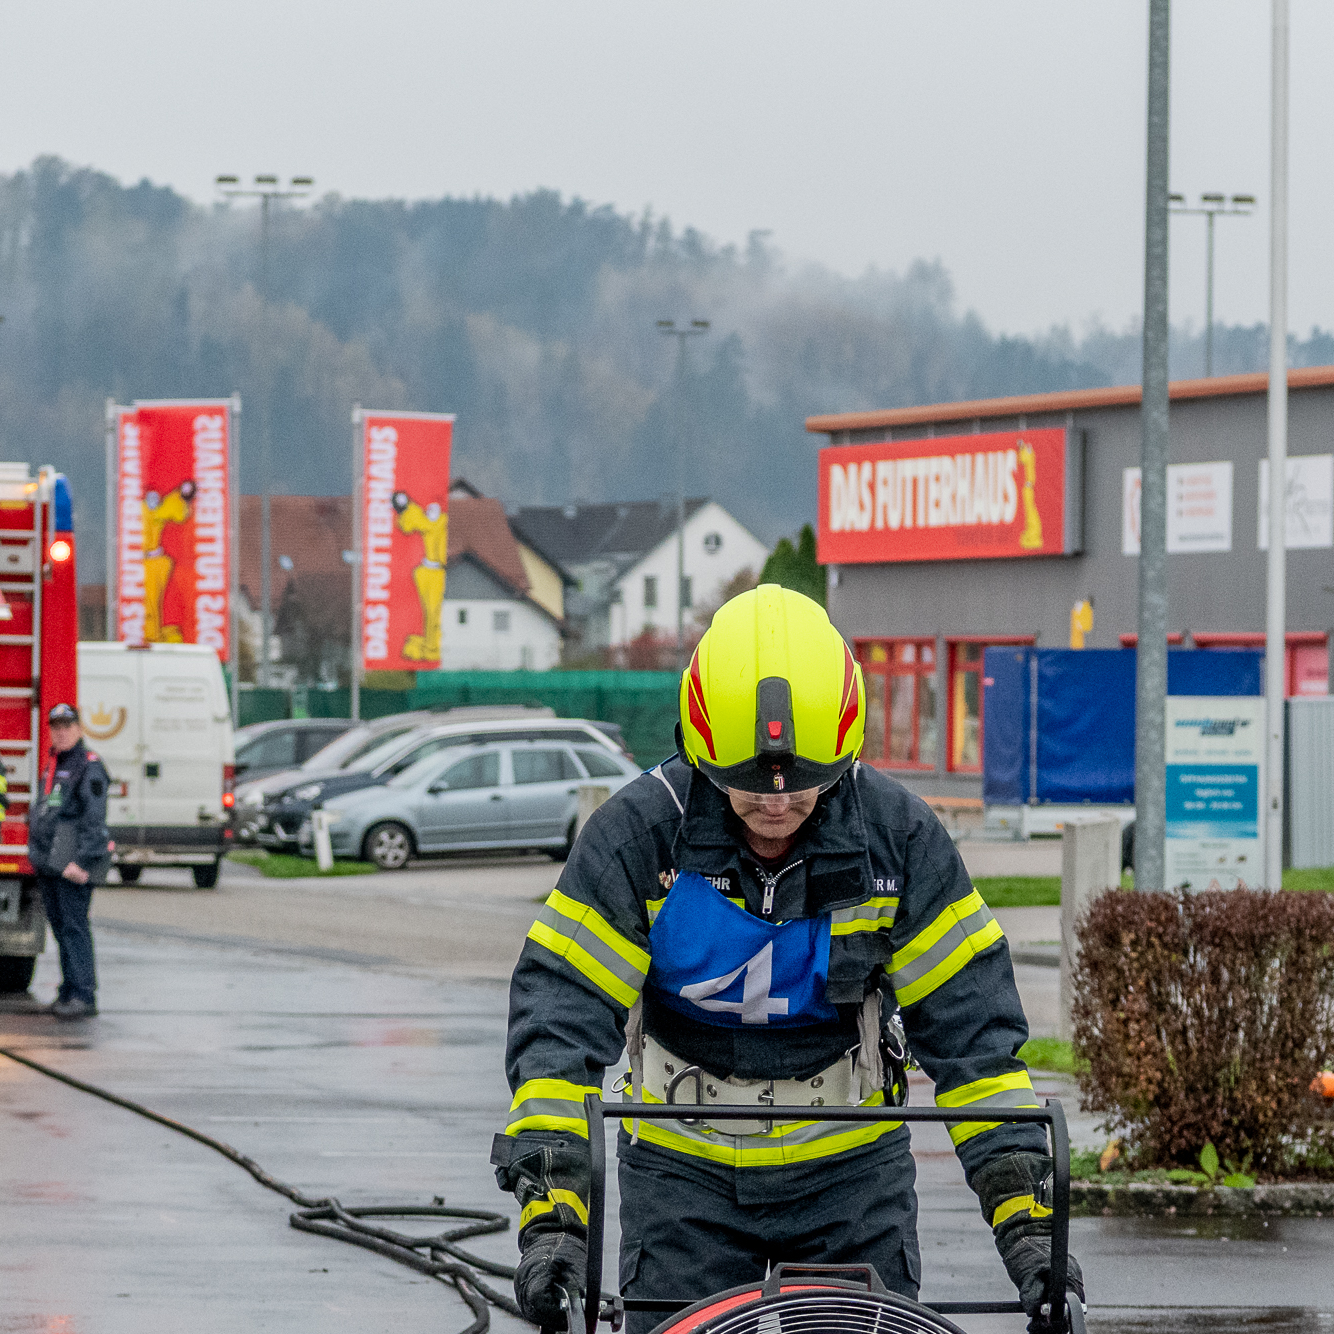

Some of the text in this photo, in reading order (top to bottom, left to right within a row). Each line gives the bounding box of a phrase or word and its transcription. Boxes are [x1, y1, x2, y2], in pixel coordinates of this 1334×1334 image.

[829, 448, 1018, 532] DAS FUTTERHAUS
[366, 426, 399, 660] DAS FUTTERHAUS
[886, 879, 898, 891] M.
[679, 940, 789, 1024] 4
